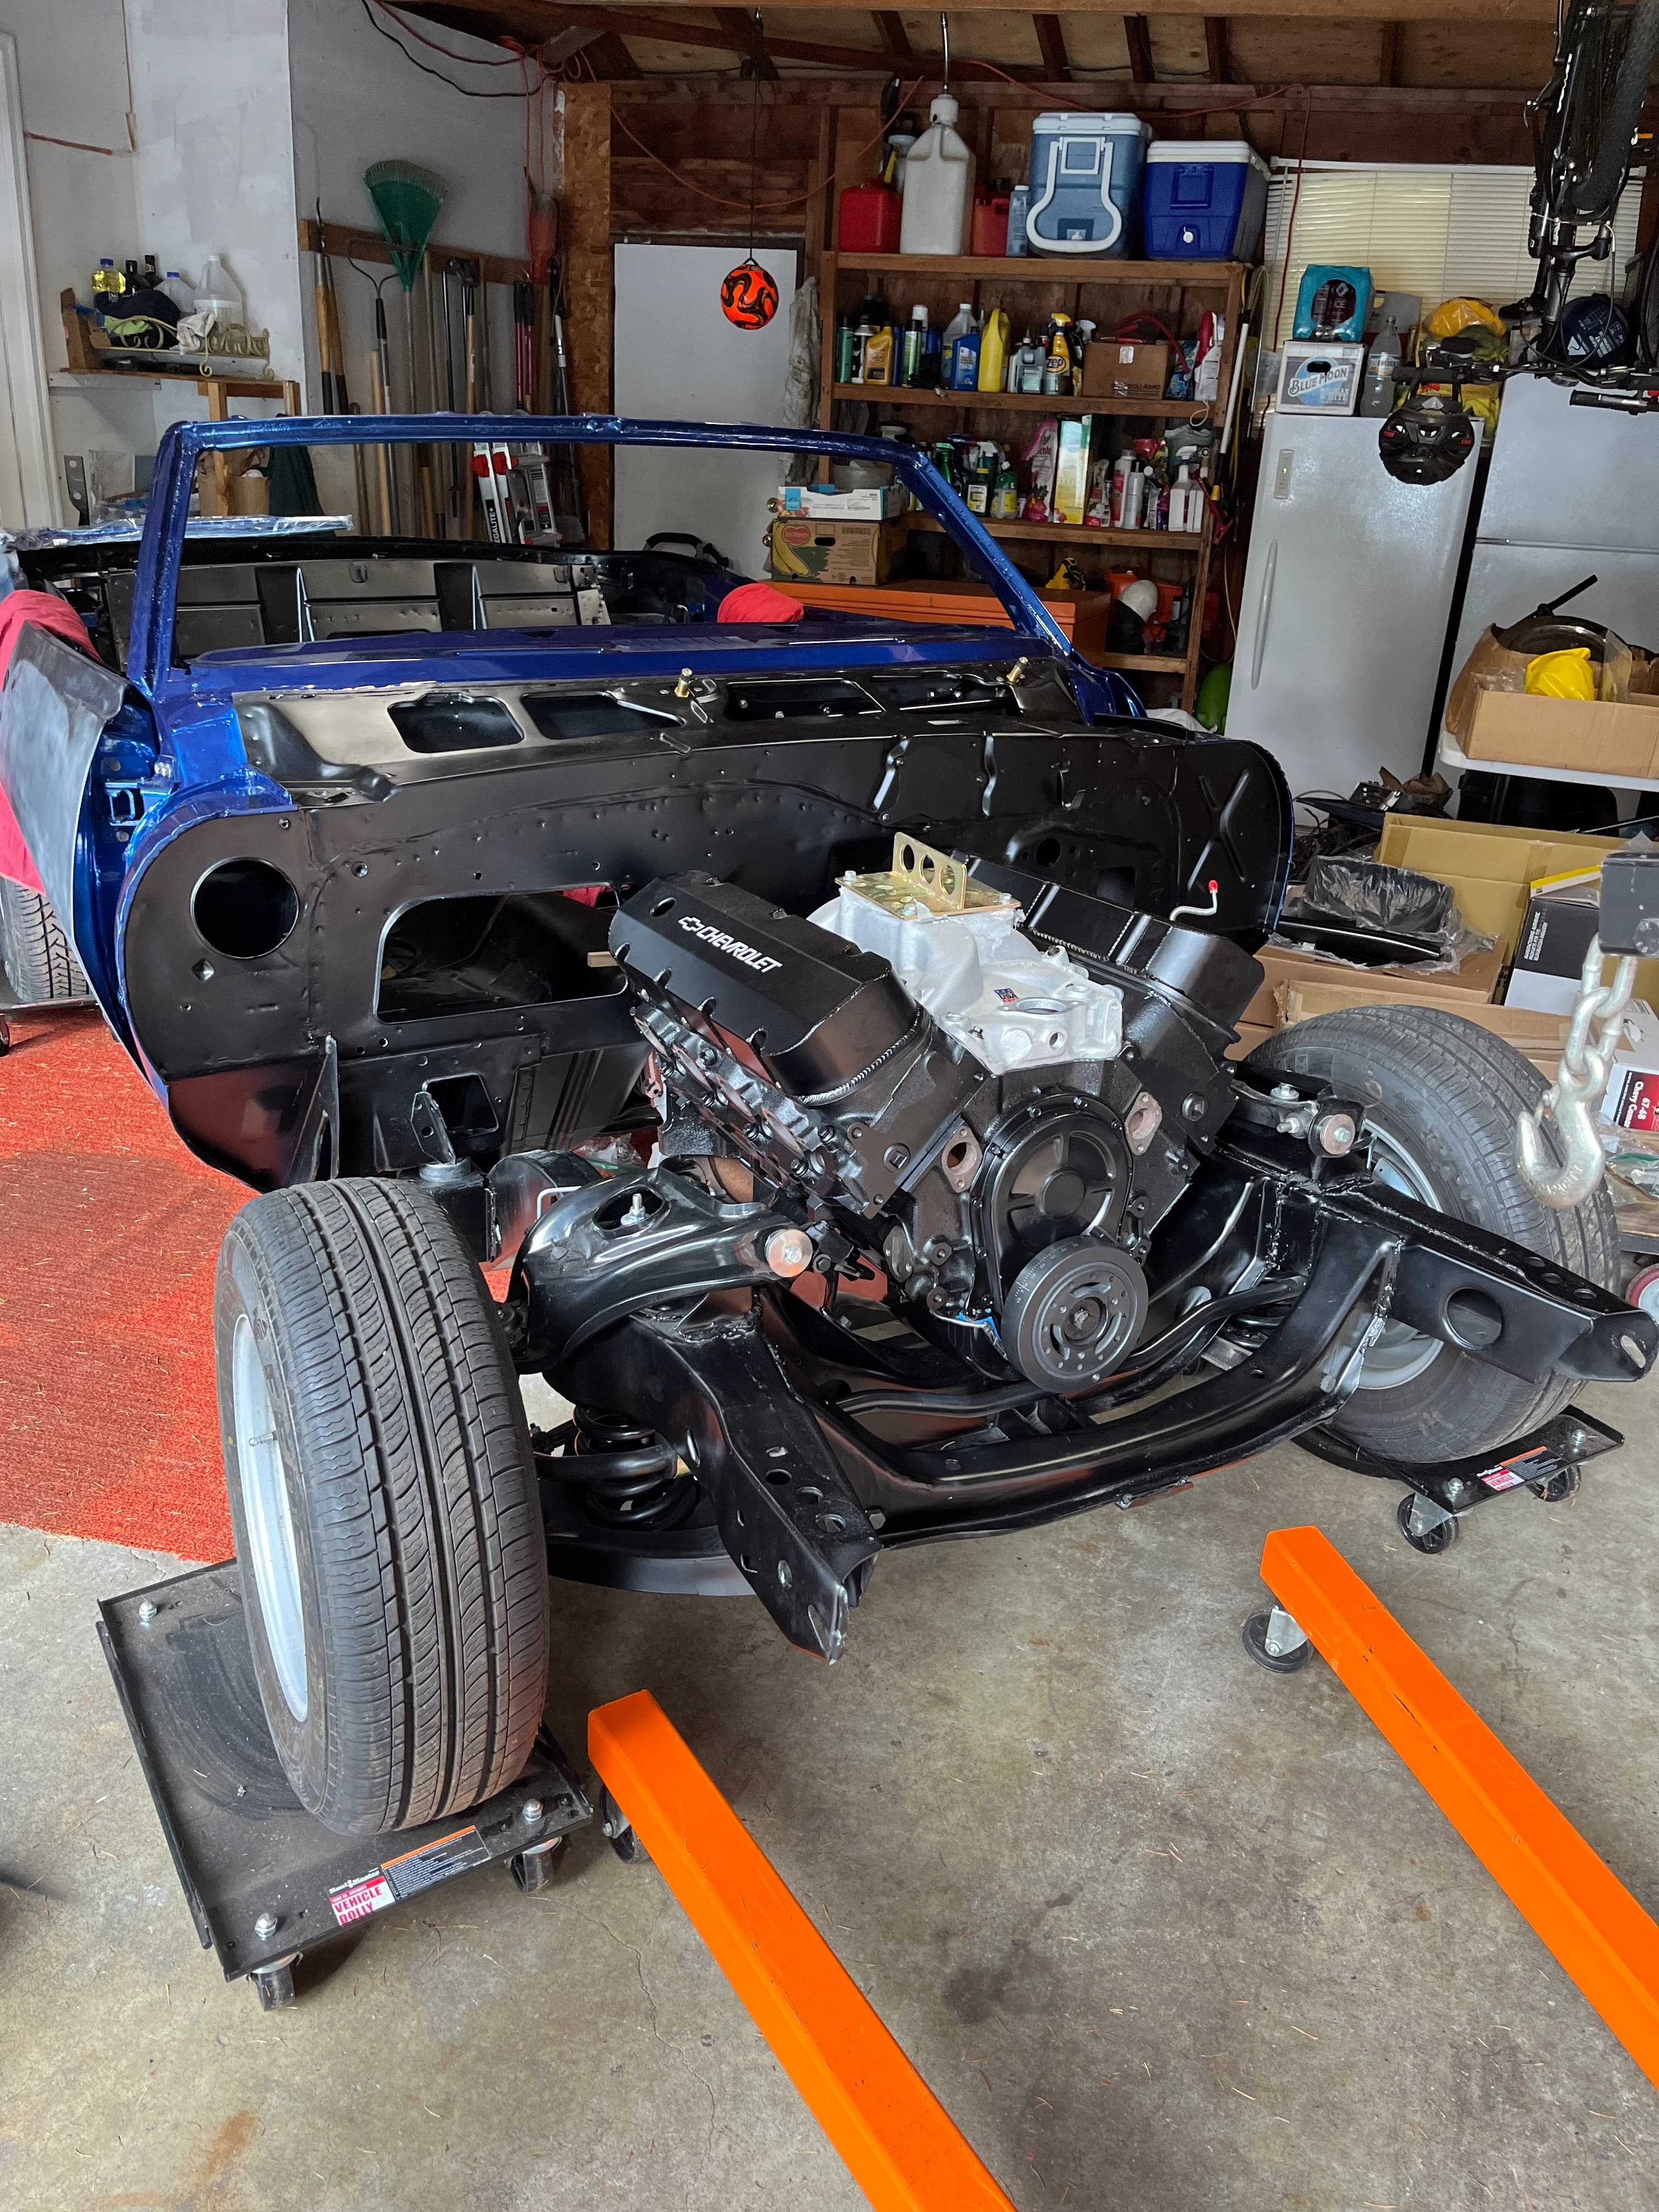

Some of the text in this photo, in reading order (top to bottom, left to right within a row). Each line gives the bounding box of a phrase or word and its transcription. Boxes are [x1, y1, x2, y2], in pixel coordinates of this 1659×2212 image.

[1289, 366, 1348, 396] BLUE MOON
[489, 507, 500, 543] EGALITE+
[842, 527, 871, 536] BANANAS
[696, 926, 783, 973] CHEVROLET
[1623, 1081, 1644, 1128] Chevy Camar
[1638, 1097, 1650, 1120] 67-68
[1488, 1474, 1516, 1487] VEHICLE
[334, 1886, 383, 1914] VEHICLE
[339, 1901, 374, 1926] DOLLY
